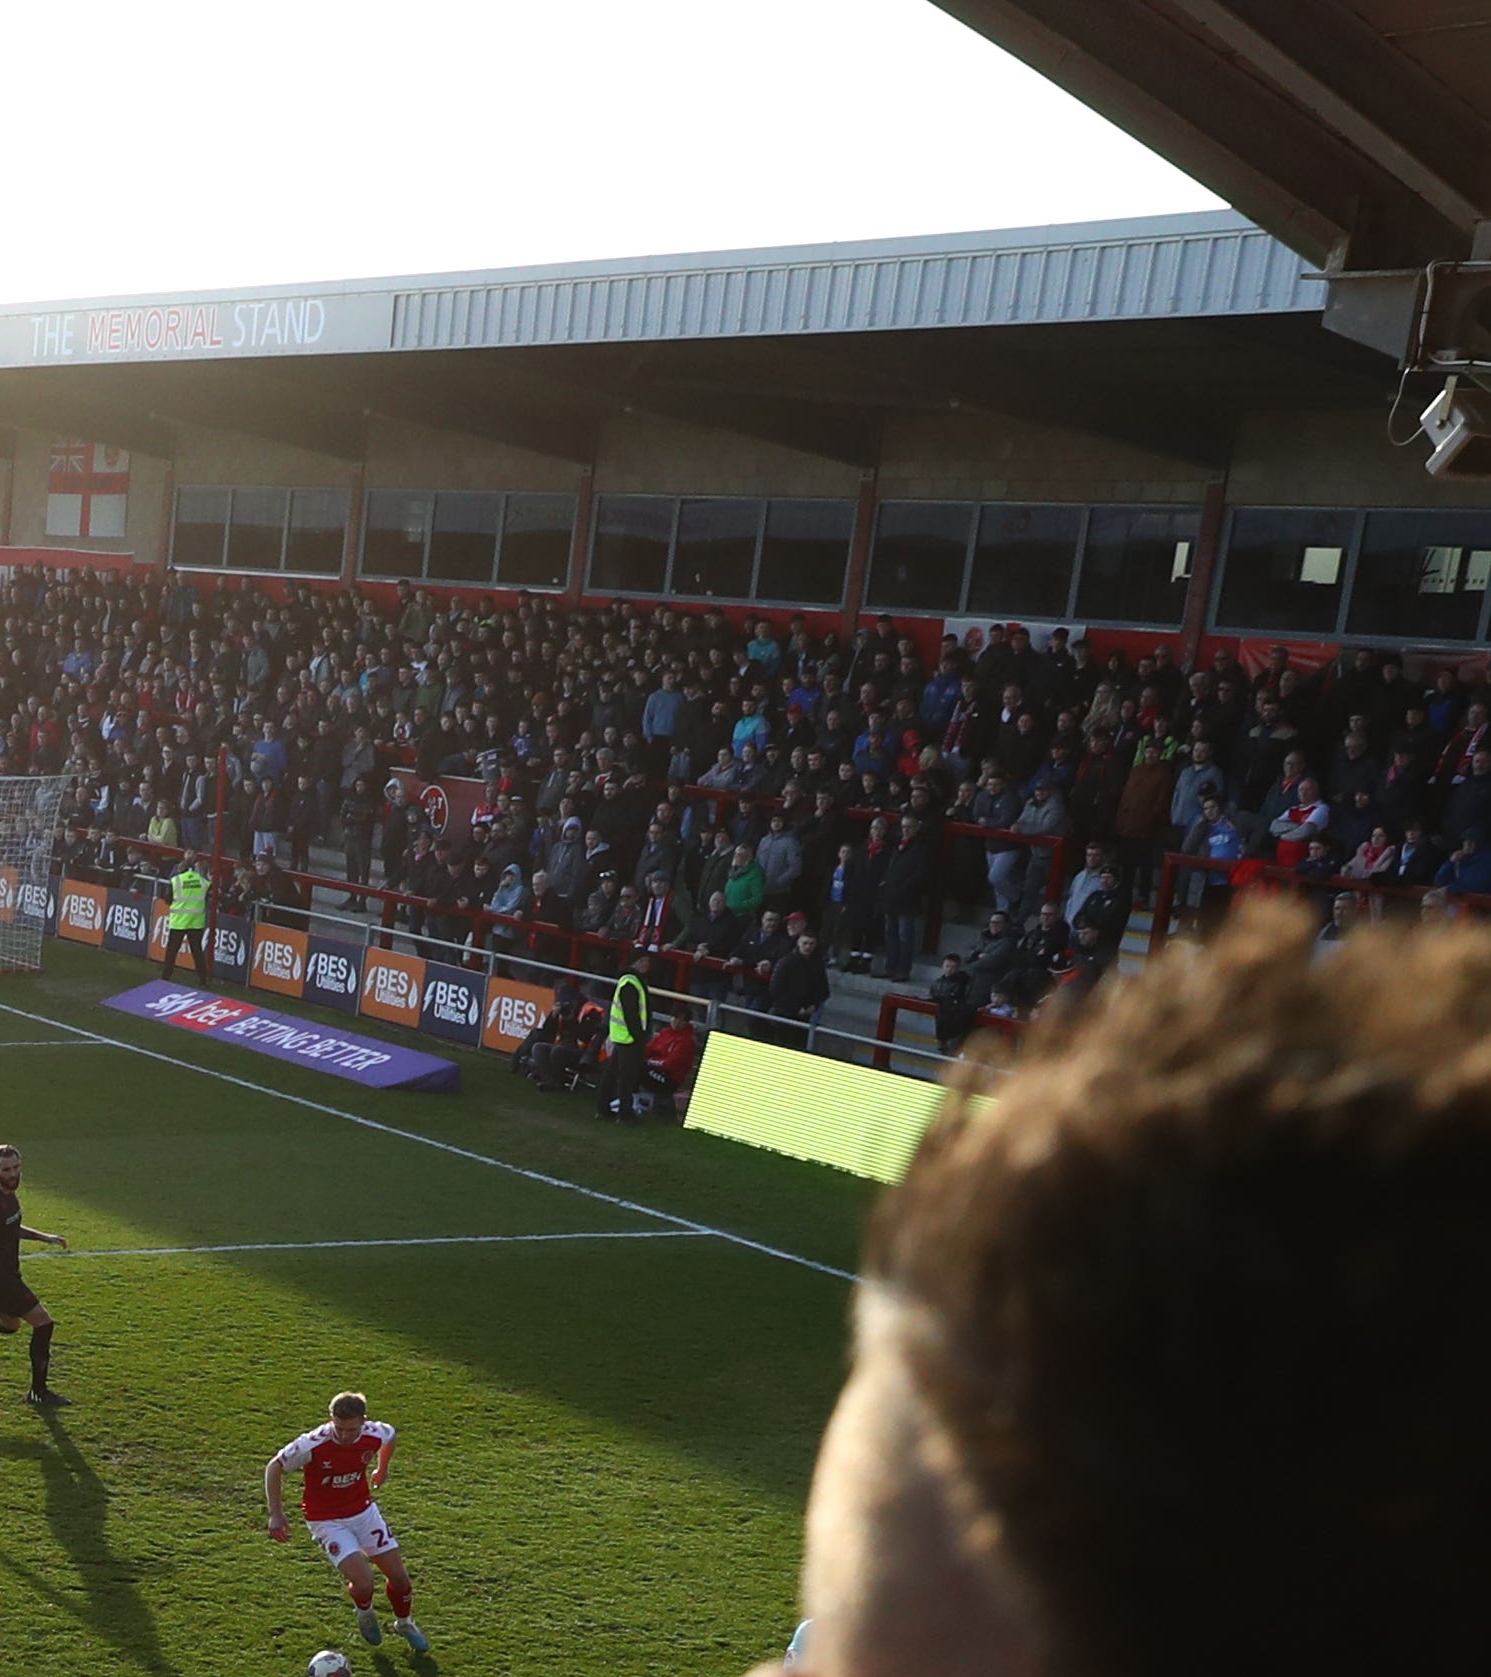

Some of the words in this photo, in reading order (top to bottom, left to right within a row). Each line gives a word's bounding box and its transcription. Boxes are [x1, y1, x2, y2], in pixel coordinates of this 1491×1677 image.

[29, 315, 75, 357] THE
[86, 305, 223, 353] MEMORIAL
[232, 299, 325, 348] STAND
[24, 884, 47, 907] BES
[71, 894, 95, 918] BES
[69, 912, 93, 930] Utilities
[114, 905, 139, 928] BES
[113, 924, 137, 942] Utilities
[264, 941, 292, 967] BES
[262, 963, 291, 981] Utilities
[319, 953, 348, 979] BES
[316, 973, 345, 994] Utilities
[376, 967, 409, 995] BES
[374, 989, 407, 1009] Utilities
[436, 982, 469, 1010] BES
[434, 1003, 466, 1025] Utilities
[500, 996, 537, 1026] BES
[145, 991, 195, 1017] sky
[182, 1000, 241, 1026] bet
[224, 1017, 312, 1050] BETTING
[303, 1038, 393, 1071] BETTER
[499, 1020, 531, 1040] Utilitie
